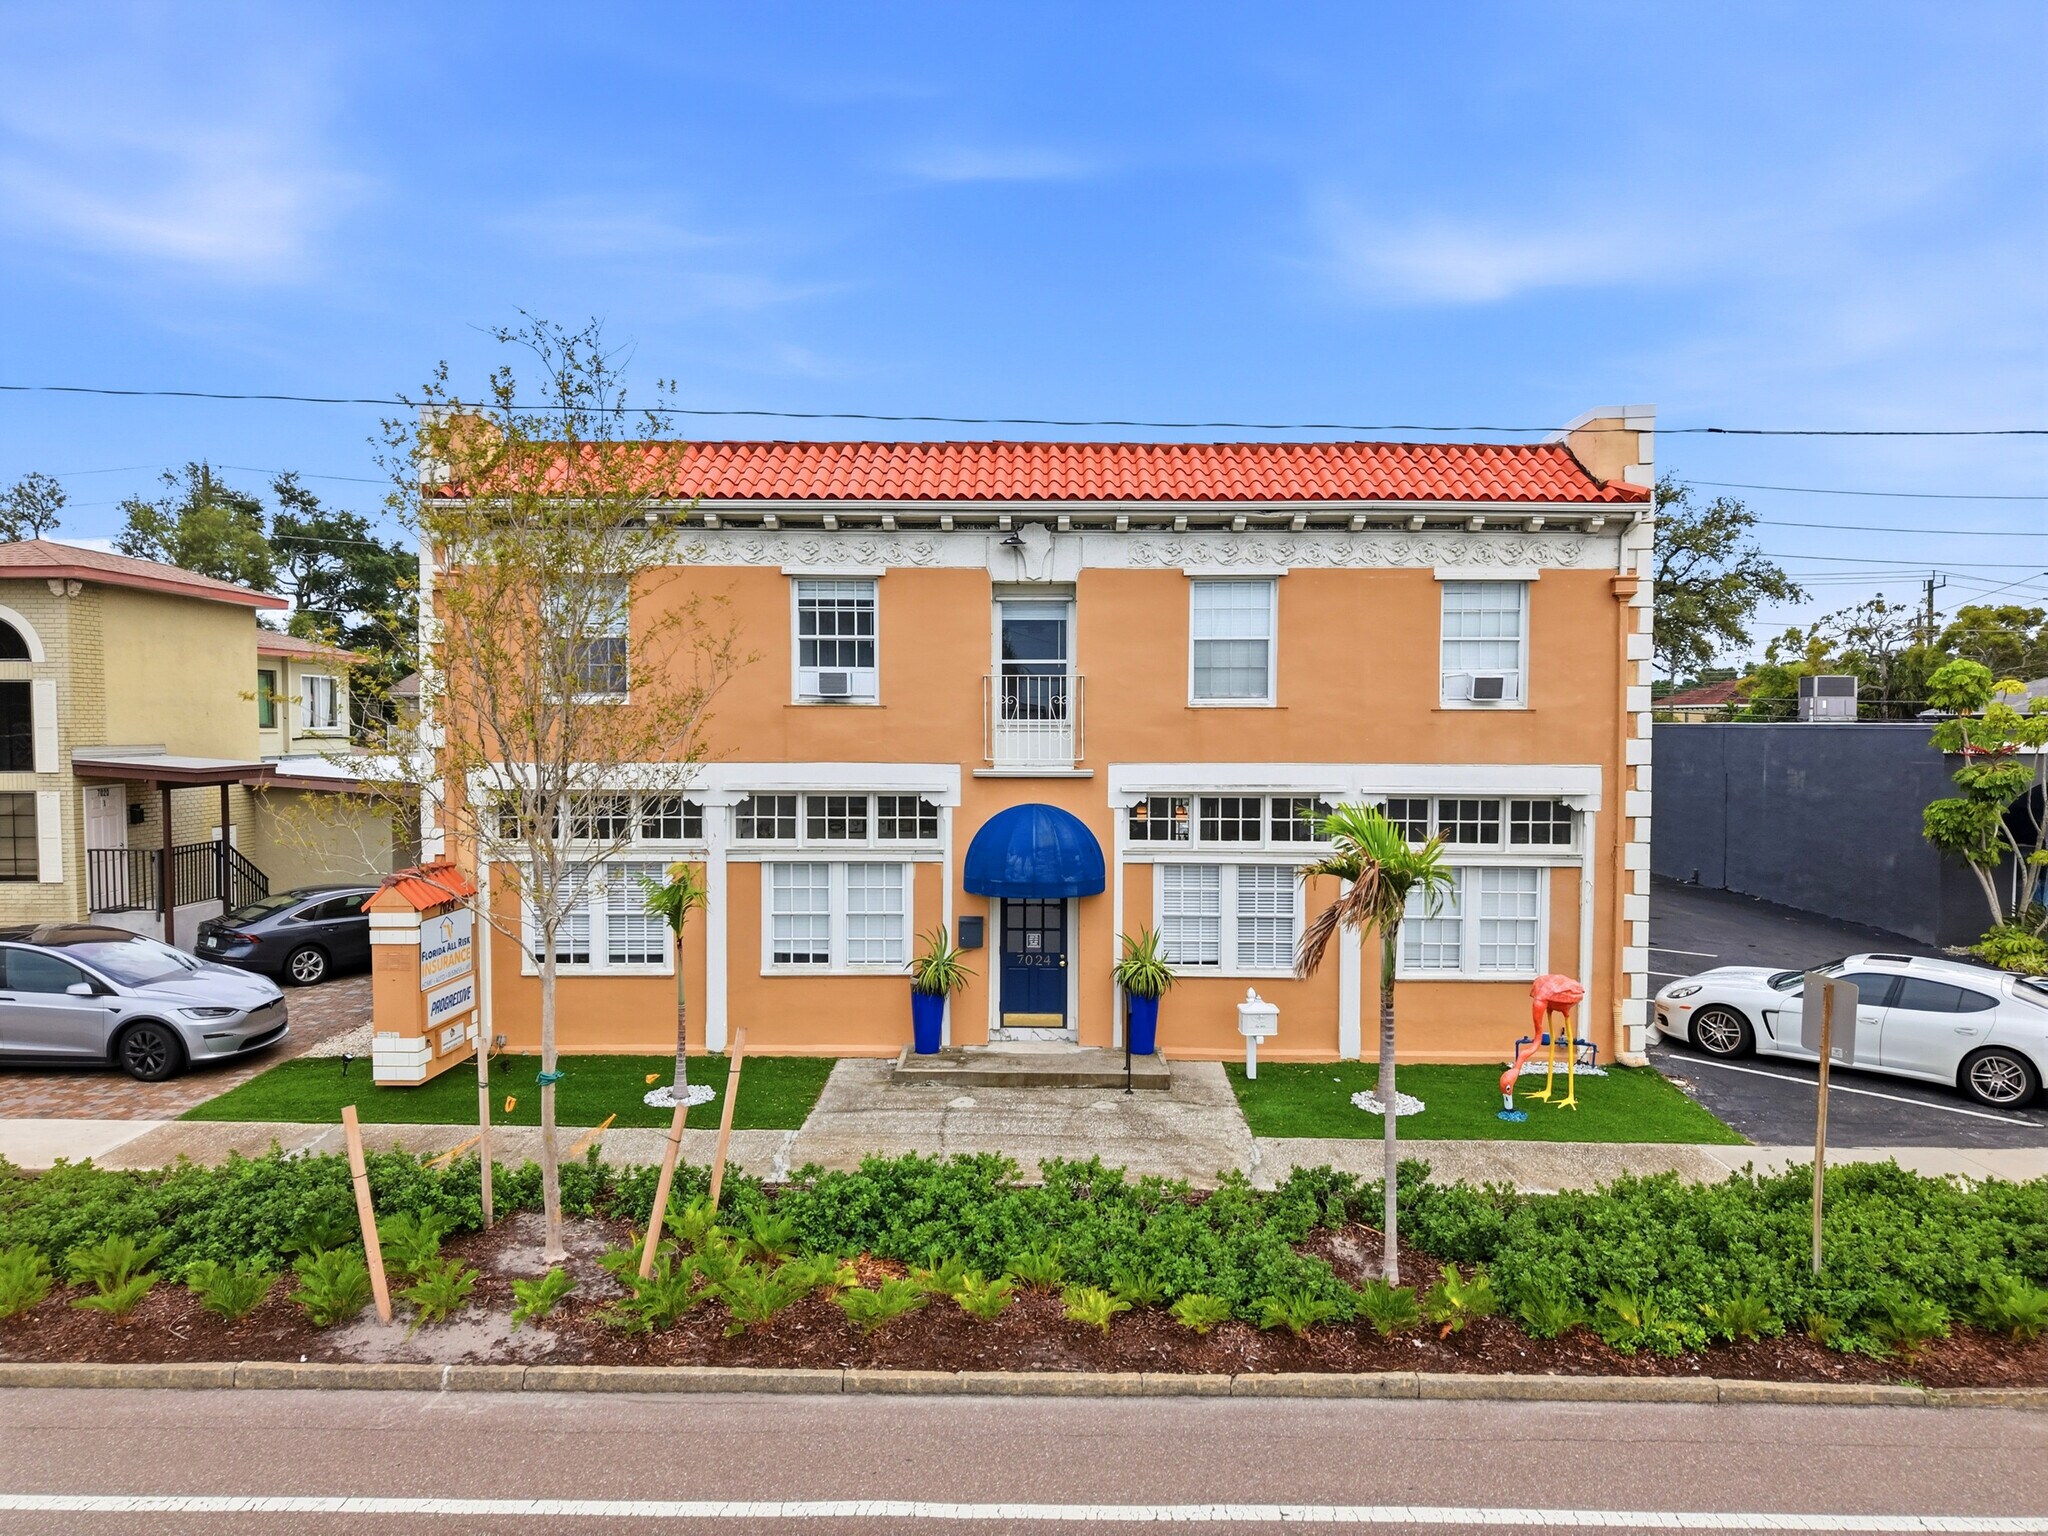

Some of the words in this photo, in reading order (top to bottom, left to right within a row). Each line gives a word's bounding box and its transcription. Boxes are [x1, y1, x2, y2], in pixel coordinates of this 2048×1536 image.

[421, 946, 446, 962] FLORIDA
[447, 942, 457, 953] ALL
[458, 936, 471, 948] RISK
[421, 947, 471, 978] INSURANCE
[1016, 954, 1051, 966] 7024
[430, 985, 472, 1017] PROGRESSIVE
